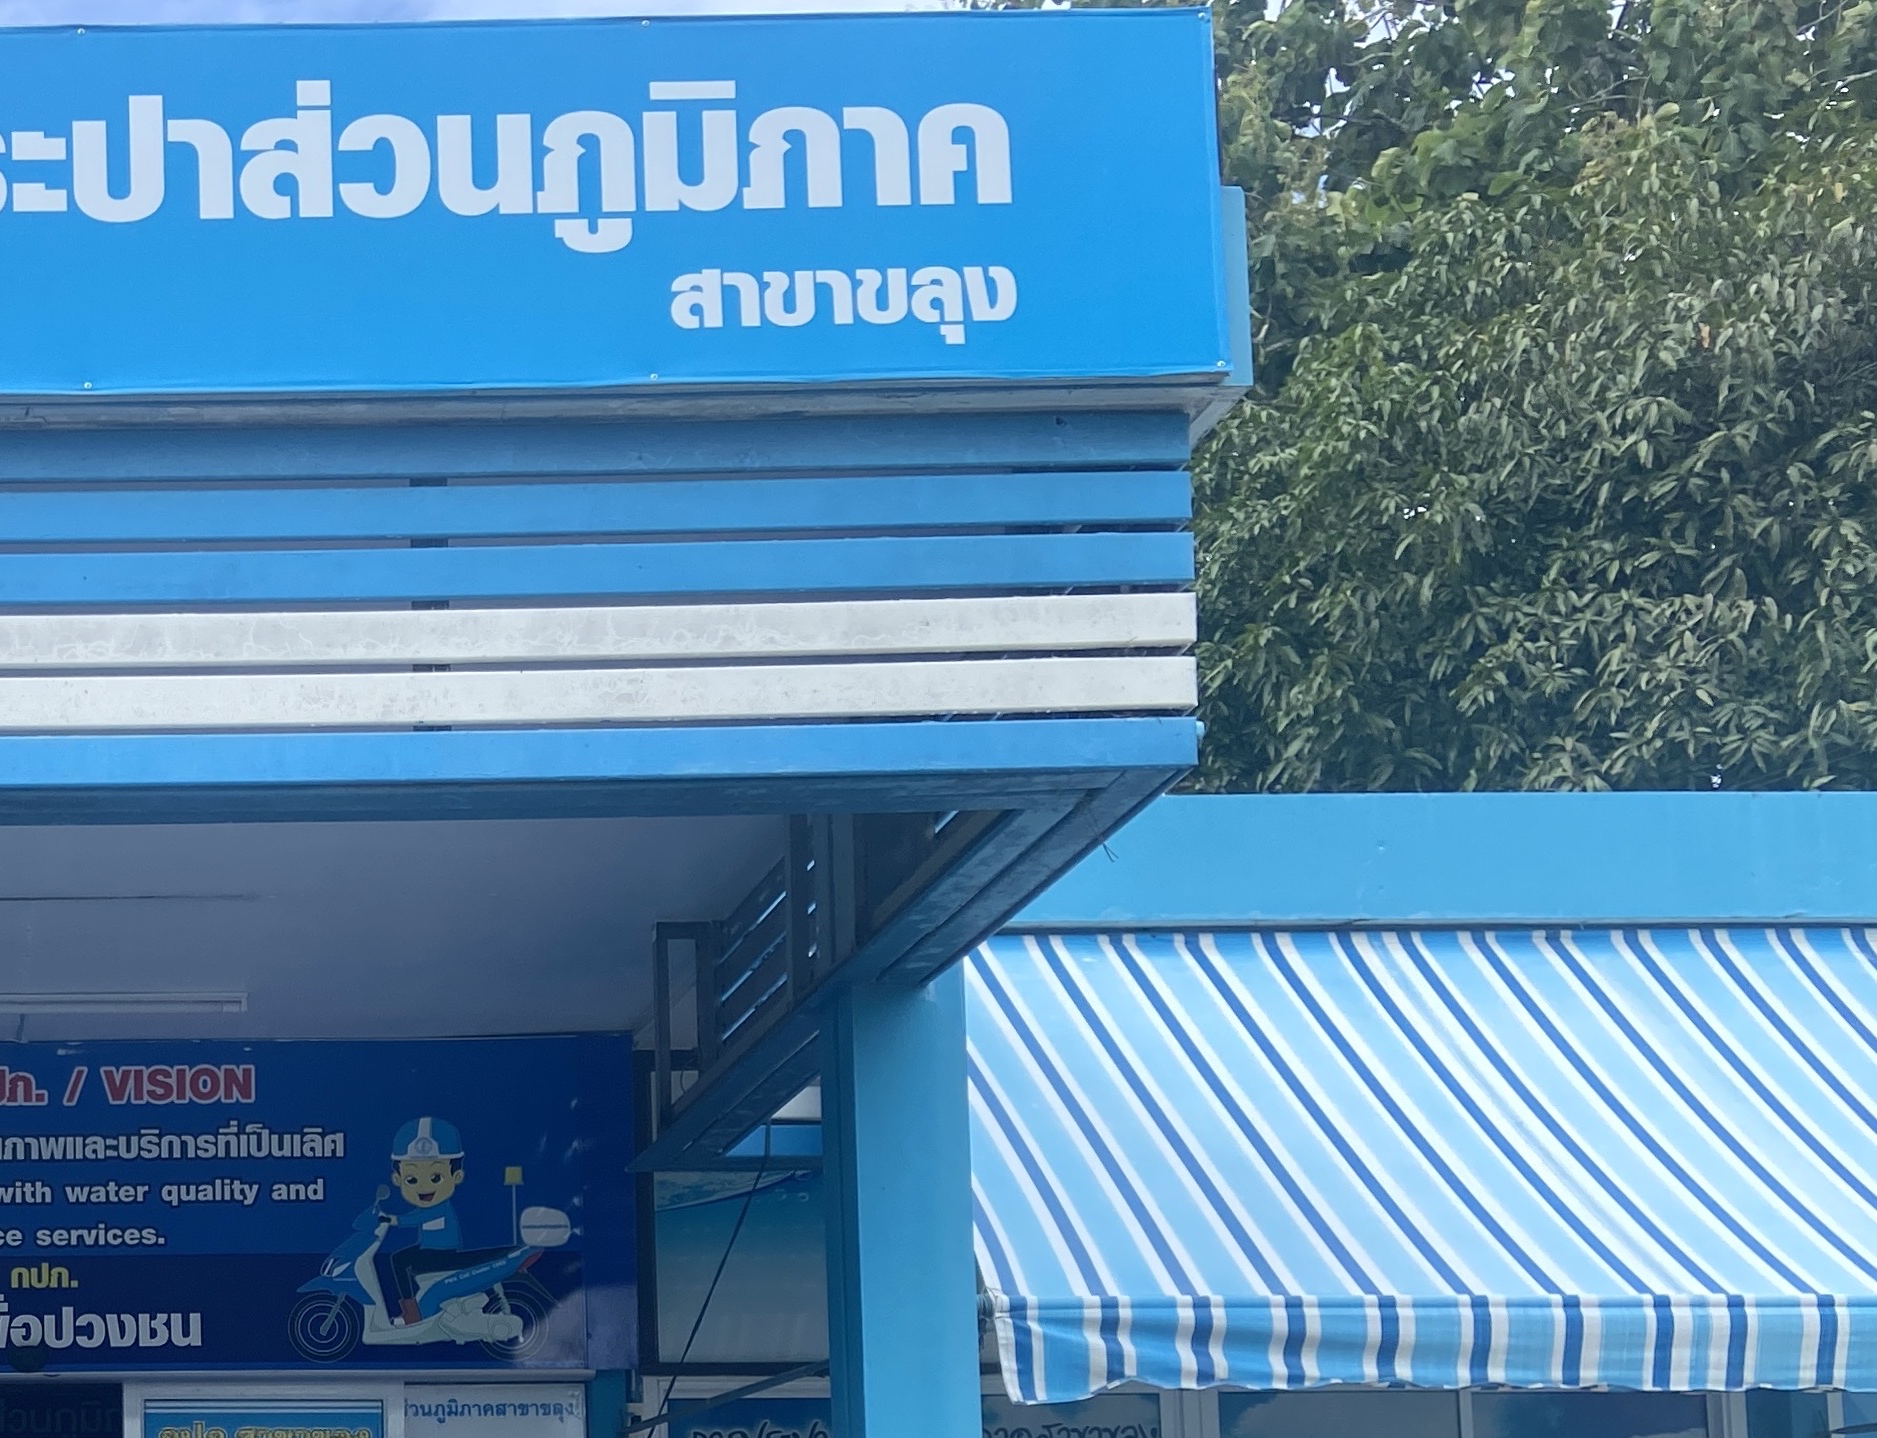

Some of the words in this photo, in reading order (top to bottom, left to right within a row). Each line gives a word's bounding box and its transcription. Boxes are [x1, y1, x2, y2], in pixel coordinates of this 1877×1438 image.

[671, 262, 1018, 345] สาขาขลุง
[63, 1066, 87, 1105] /
[101, 1064, 256, 1104] VISION
[65, 1184, 148, 1204] water
[161, 1179, 259, 1206] quality
[271, 1178, 324, 1201] and
[35, 1224, 167, 1247] services.
[11, 1262, 79, 1289] กปภ.
